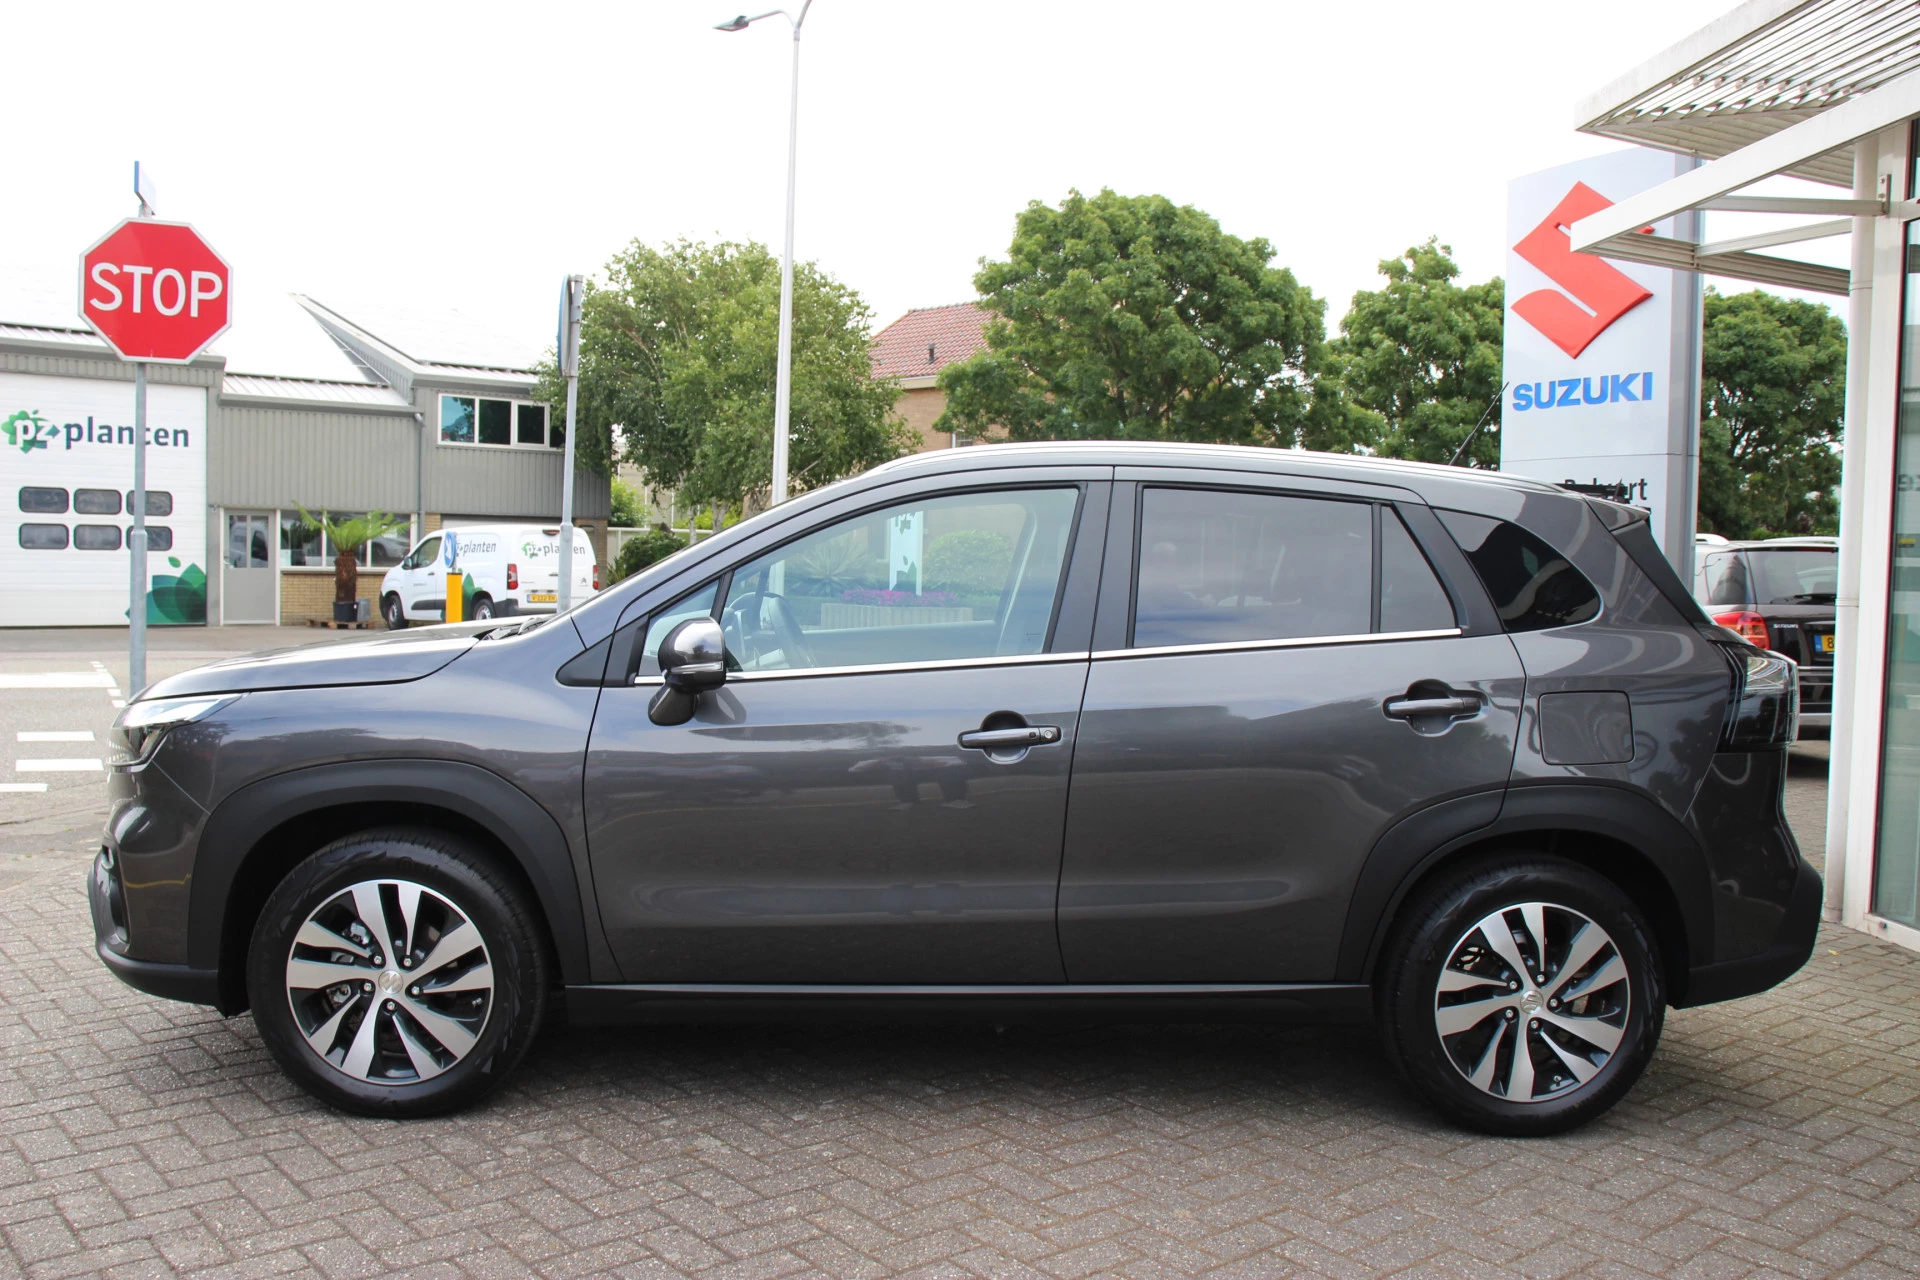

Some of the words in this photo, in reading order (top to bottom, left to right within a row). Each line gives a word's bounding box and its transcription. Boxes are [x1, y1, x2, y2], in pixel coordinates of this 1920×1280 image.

[89, 262, 223, 318] STOP
[1512, 371, 1653, 412] SUZUKI
[463, 540, 497, 556] planten
[543, 542, 586, 557] plaen
